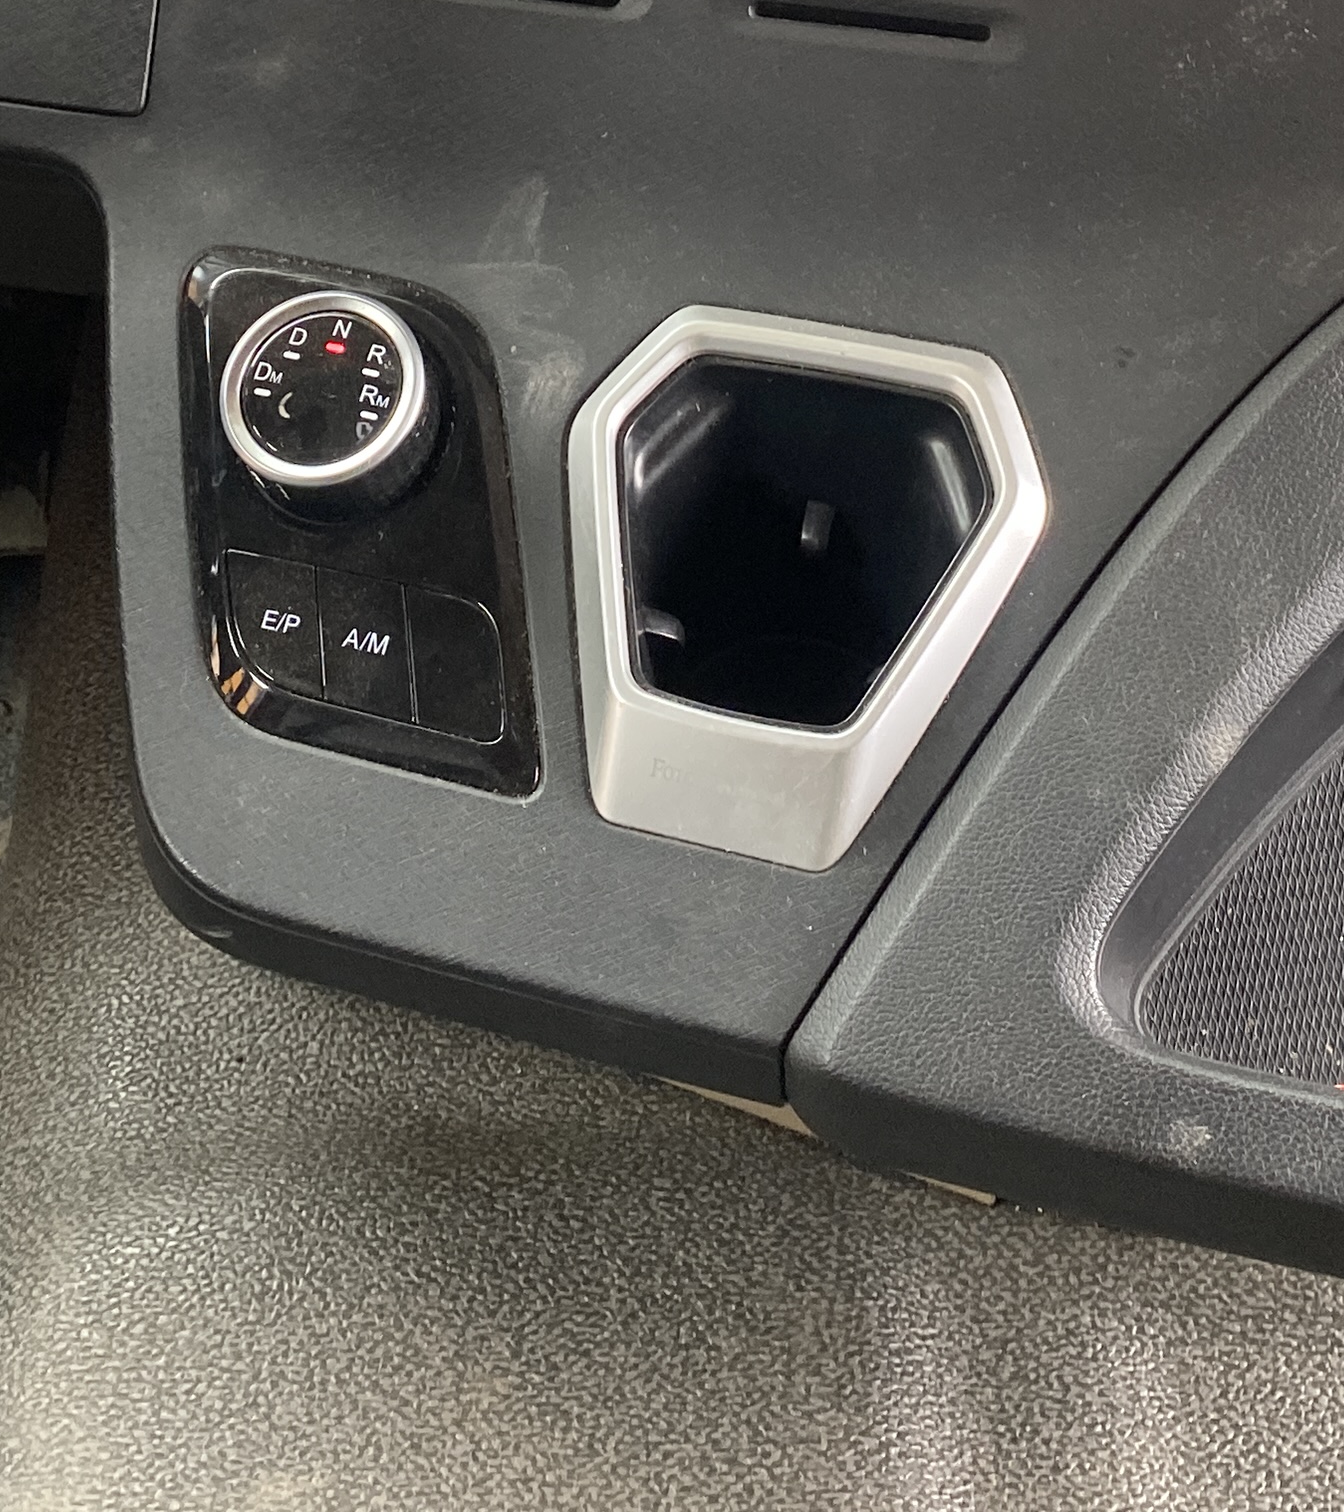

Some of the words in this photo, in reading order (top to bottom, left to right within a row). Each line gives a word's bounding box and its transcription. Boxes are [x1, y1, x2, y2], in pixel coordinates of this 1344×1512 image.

[288, 327, 308, 346] D
[332, 319, 353, 339] N
[366, 344, 387, 365] R
[260, 609, 302, 634] E/P
[341, 627, 391, 656] A/M
